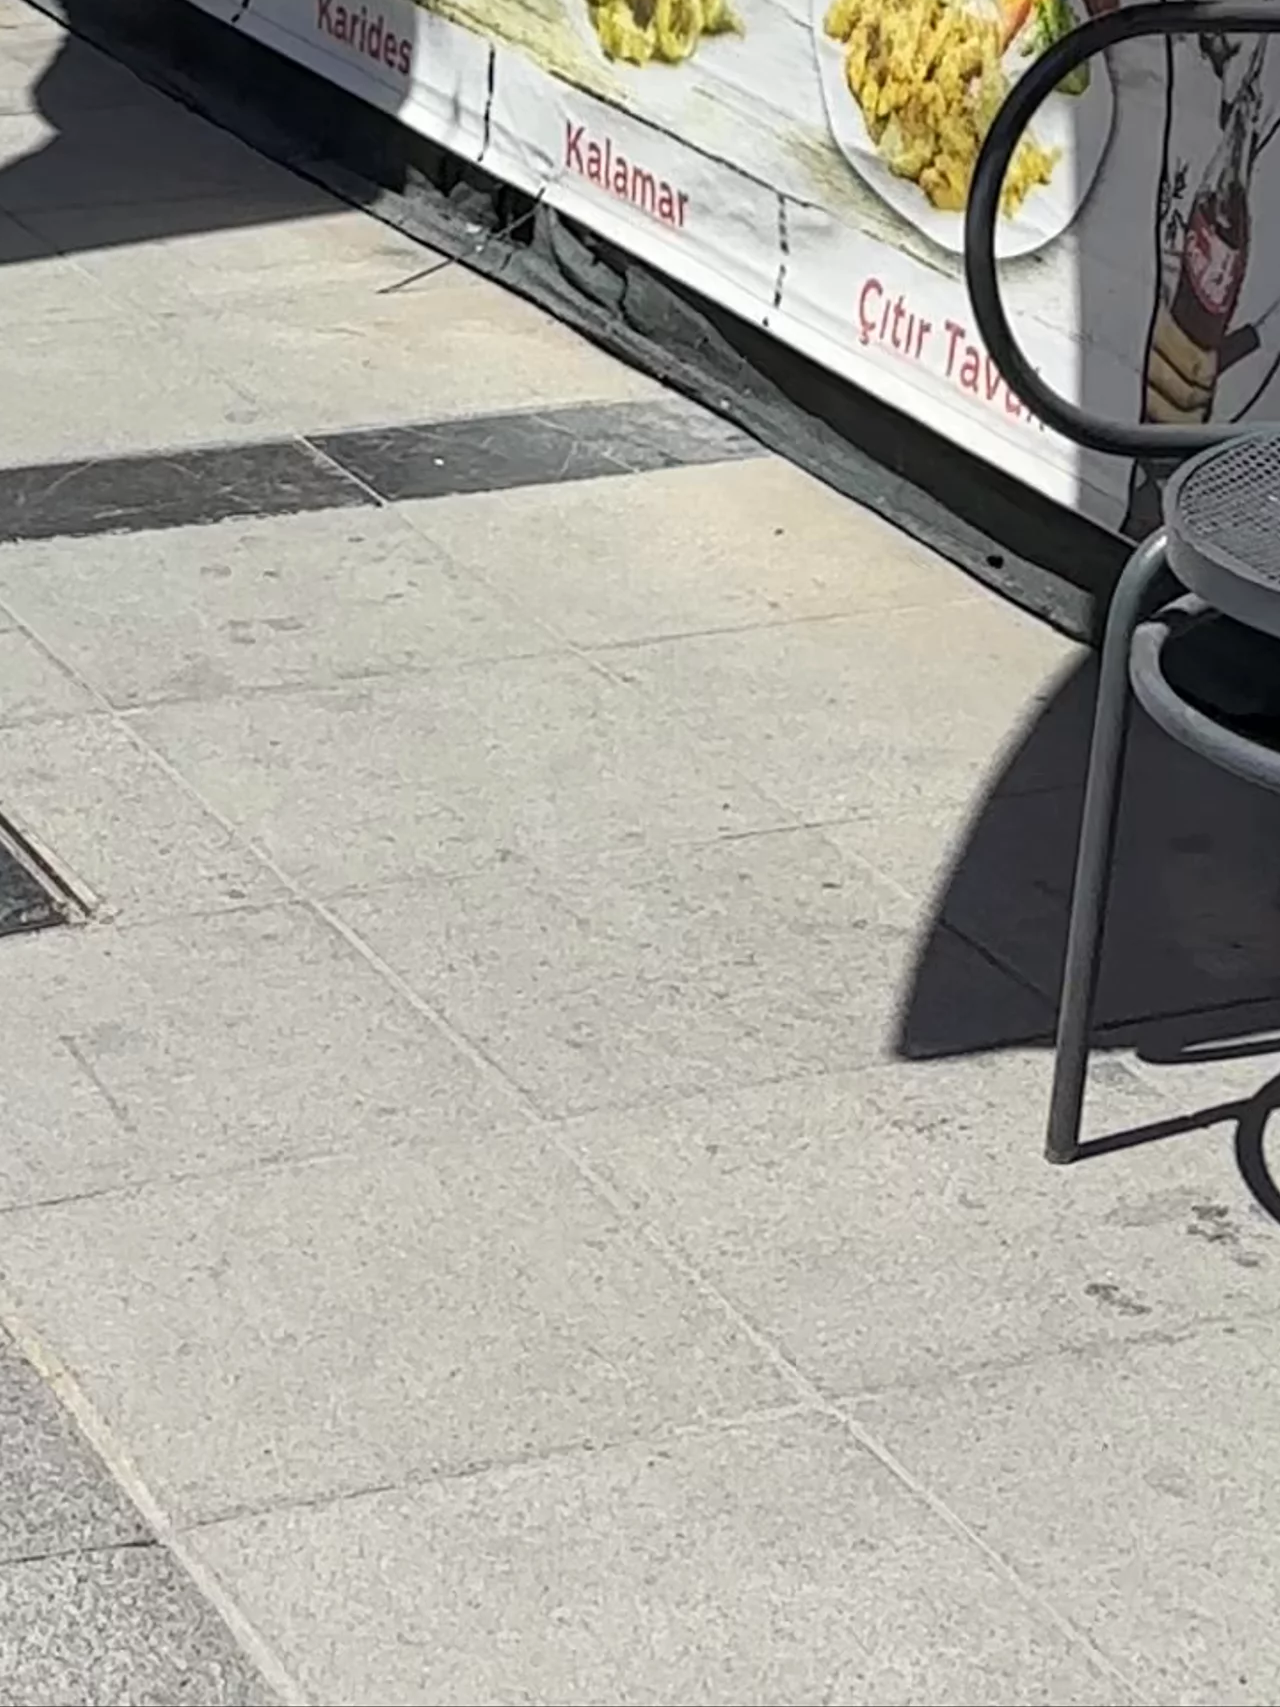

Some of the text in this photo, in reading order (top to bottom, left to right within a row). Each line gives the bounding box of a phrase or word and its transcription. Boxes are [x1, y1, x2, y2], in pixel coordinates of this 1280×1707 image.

[565, 120, 689, 228] Kalamar
[858, 277, 1045, 432] Çıtır Tav
